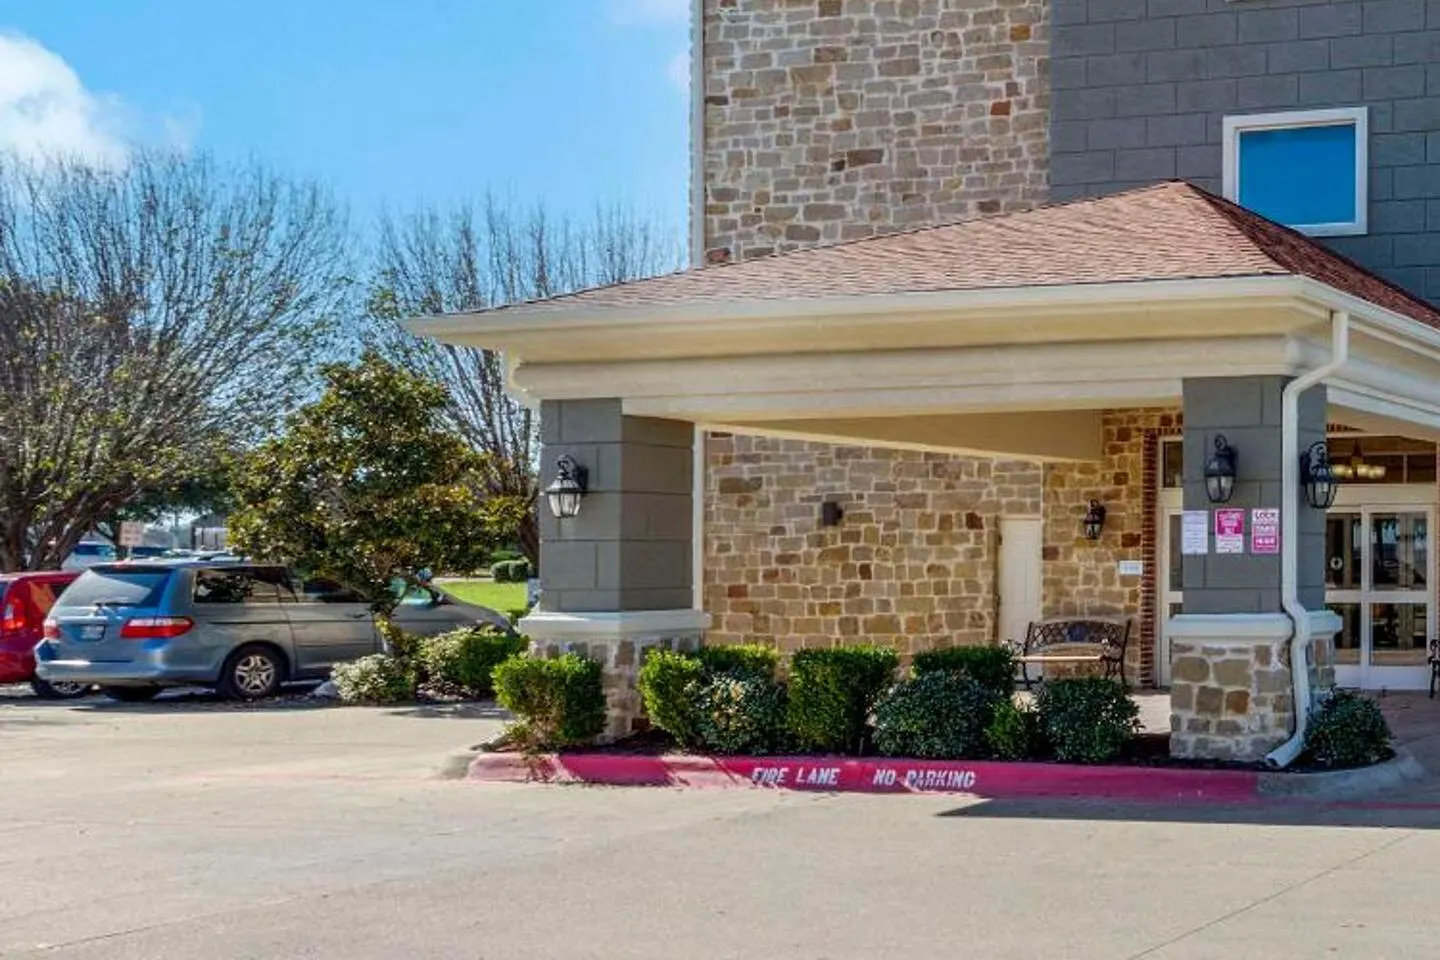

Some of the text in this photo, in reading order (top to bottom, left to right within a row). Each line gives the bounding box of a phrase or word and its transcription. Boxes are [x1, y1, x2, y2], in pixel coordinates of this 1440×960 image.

[752, 767, 976, 789] FIRE LANE NO PARKING
